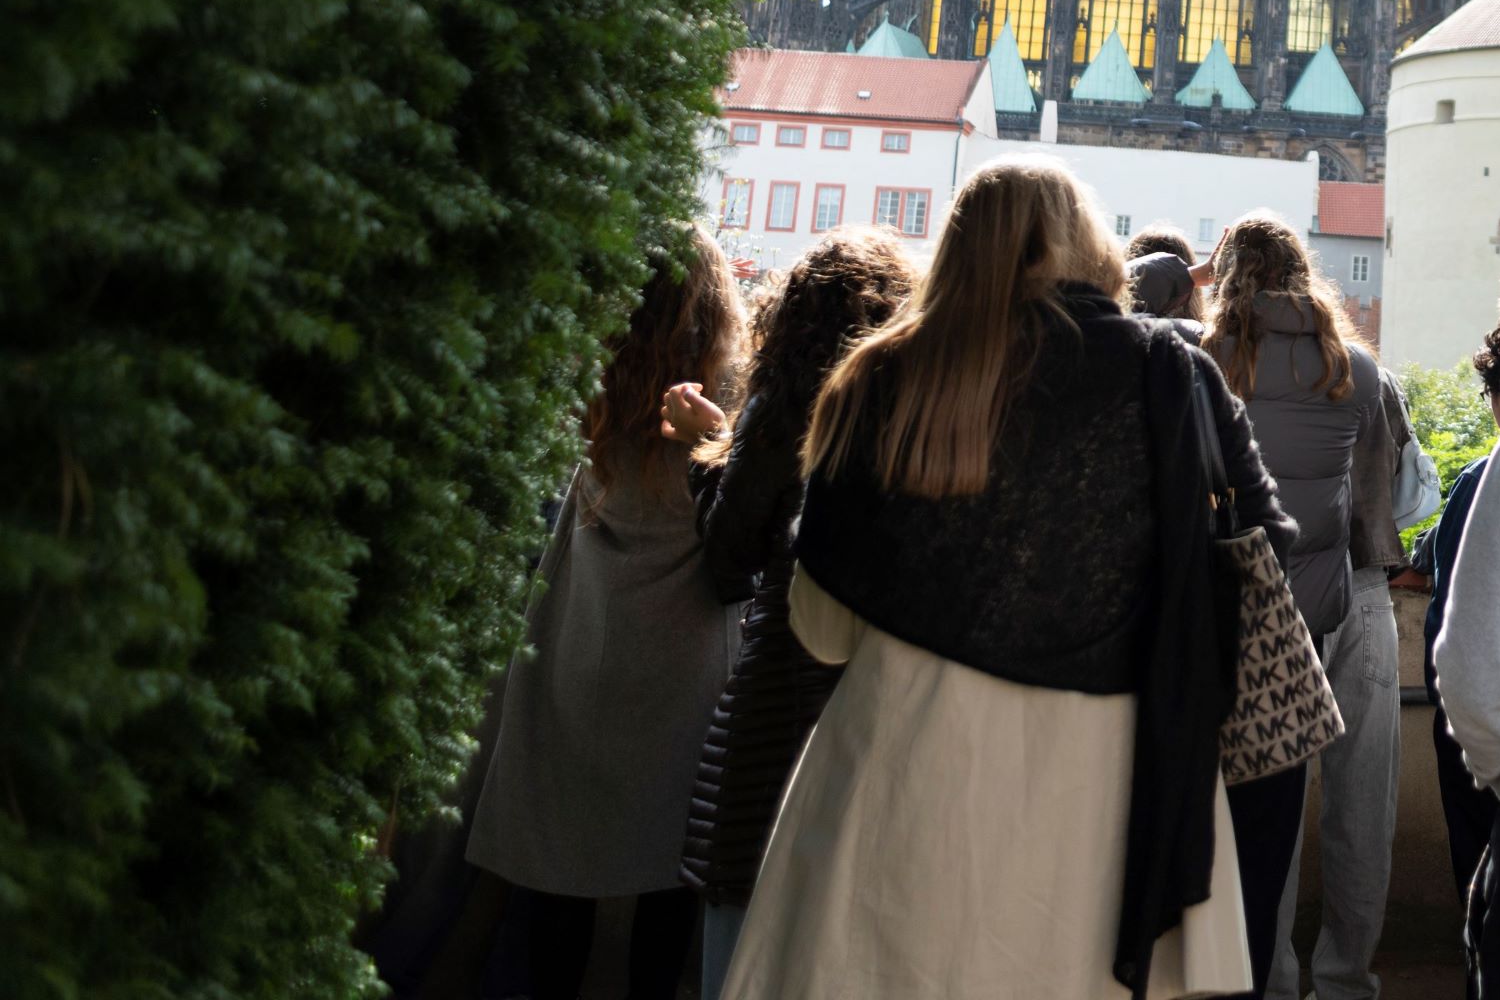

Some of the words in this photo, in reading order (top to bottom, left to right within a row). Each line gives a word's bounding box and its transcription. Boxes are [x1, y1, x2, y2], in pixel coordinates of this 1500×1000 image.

[1232, 693, 1269, 722] MK
[1269, 673, 1313, 711] MK
[1245, 661, 1285, 692] MK
[1220, 724, 1256, 749] MK
[1255, 710, 1296, 742] MK
[1242, 742, 1284, 776] MK
[1282, 722, 1323, 760] MK
